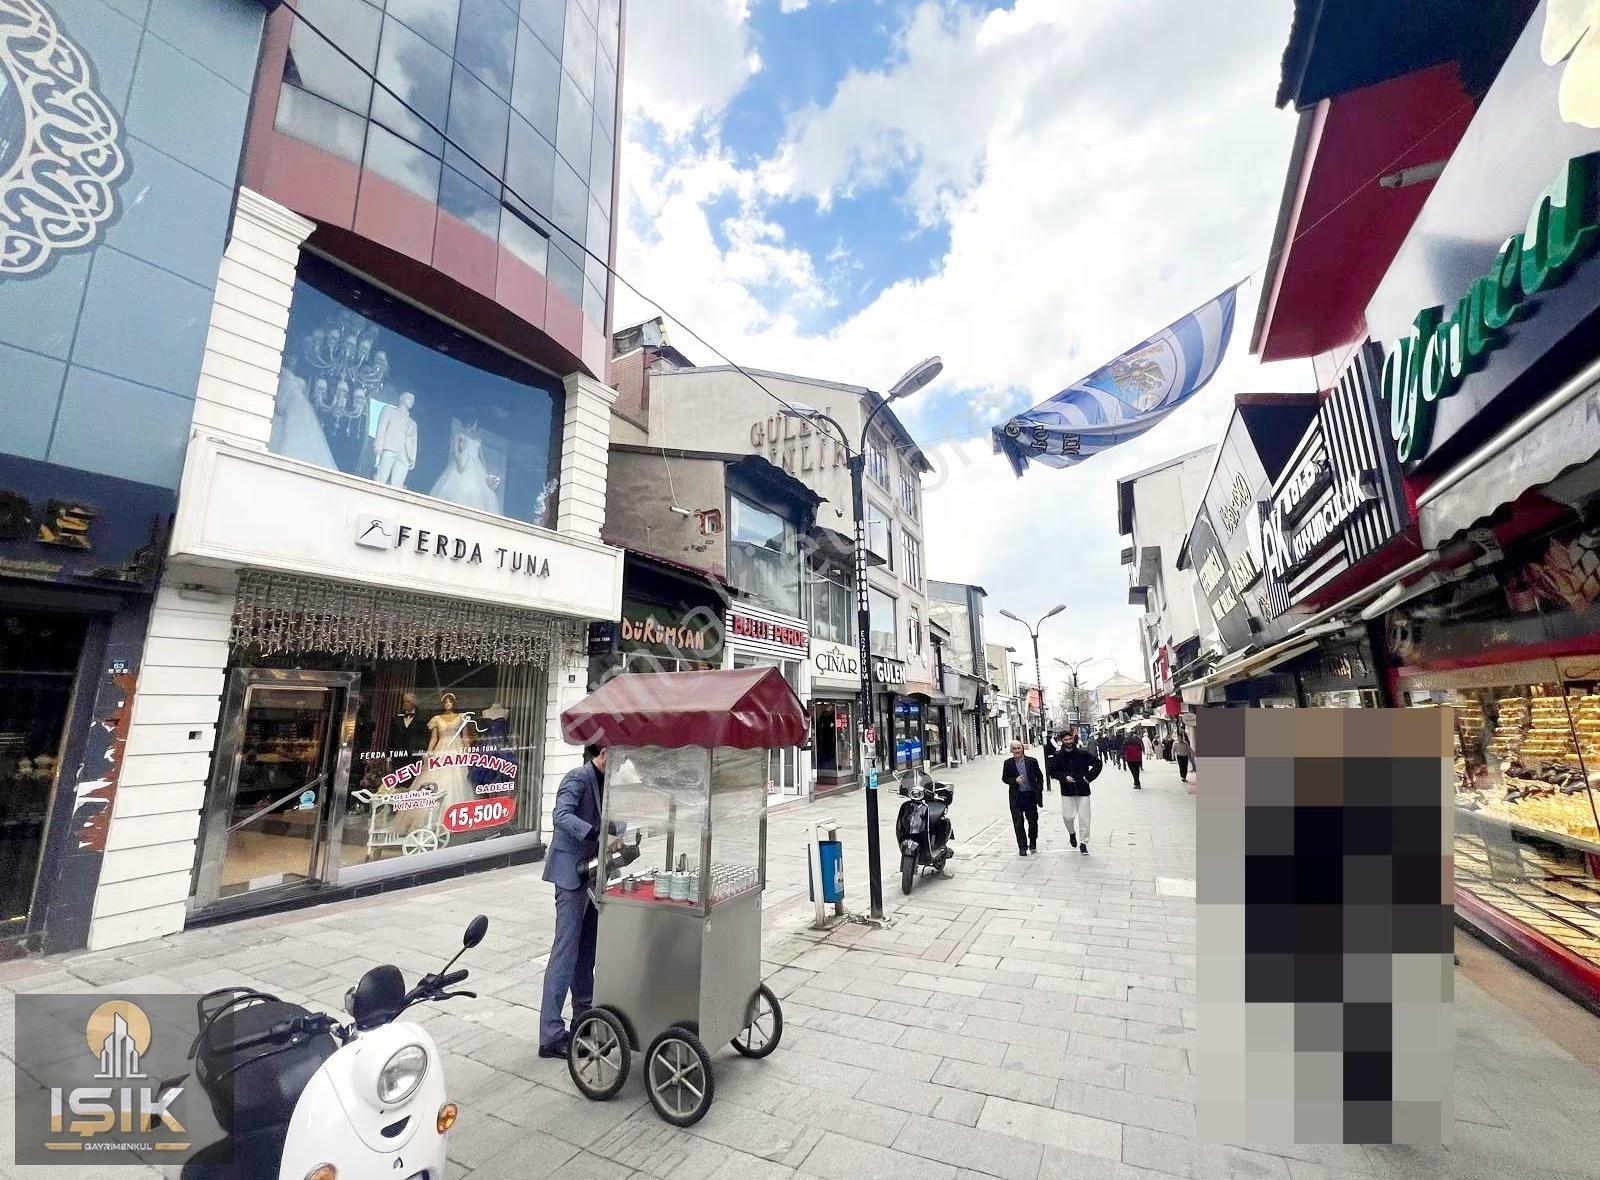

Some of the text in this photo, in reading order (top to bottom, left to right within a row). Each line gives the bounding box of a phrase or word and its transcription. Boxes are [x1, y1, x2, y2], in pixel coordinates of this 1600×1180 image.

[1293, 470, 1366, 562] KUYUMCULUK
[396, 525, 551, 578] FERDA TUNA
[1263, 500, 1292, 584] AK
[733, 614, 807, 648] BULUT PERDE
[815, 652, 858, 675] ÇINAR
[860, 630, 869, 680] ERZURUM
[876, 658, 907, 684] GÜLEN
[360, 751, 386, 760] FERDA
[389, 750, 409, 758] TUNA
[382, 754, 518, 790] DEV KAMPANYA
[475, 781, 515, 795] SADECE
[393, 799, 438, 812] KINALIK
